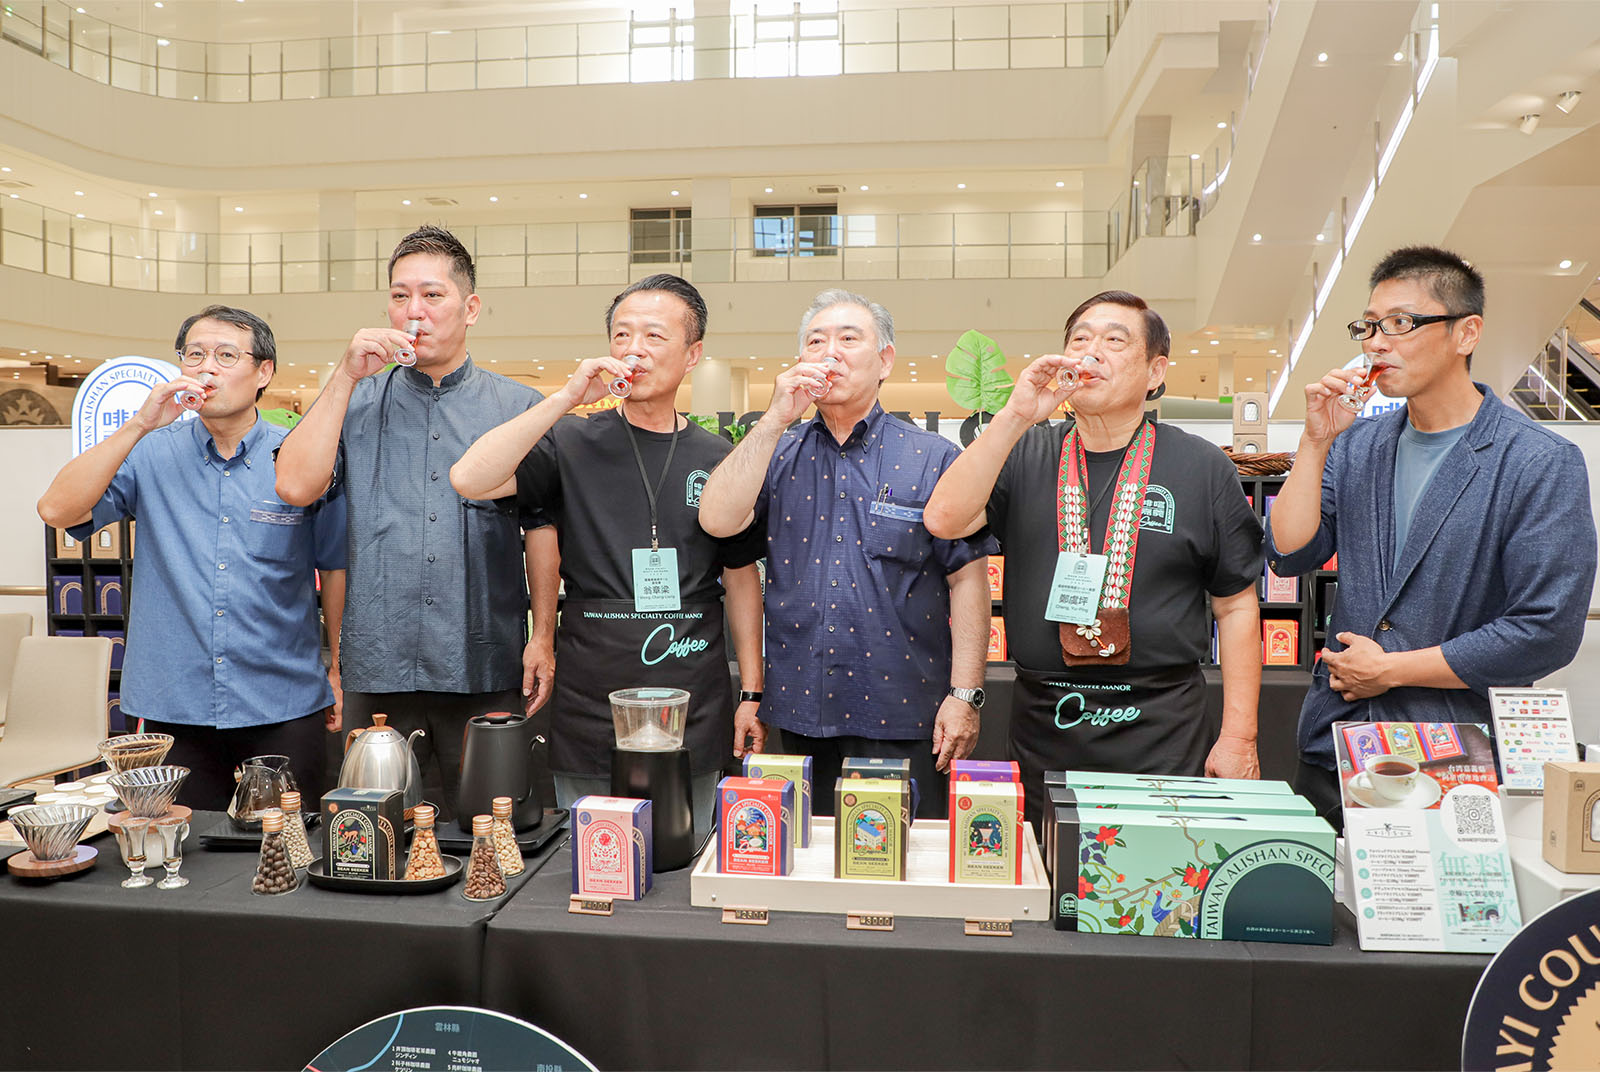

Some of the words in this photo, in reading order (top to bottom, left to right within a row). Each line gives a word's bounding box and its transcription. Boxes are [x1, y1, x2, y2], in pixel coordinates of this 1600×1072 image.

[84, 377, 109, 422] ALISHAN
[109, 369, 158, 385] SPECIALTY
[583, 611, 602, 619] TAIWAN
[603, 612, 629, 620] ALISHAN
[630, 612, 662, 620] SPECIALTY
[641, 623, 709, 665] Coffee
[1054, 692, 1141, 729] Coffee
[1206, 878, 1228, 937] TAIWAN
[1226, 847, 1290, 879] ALISHAN
